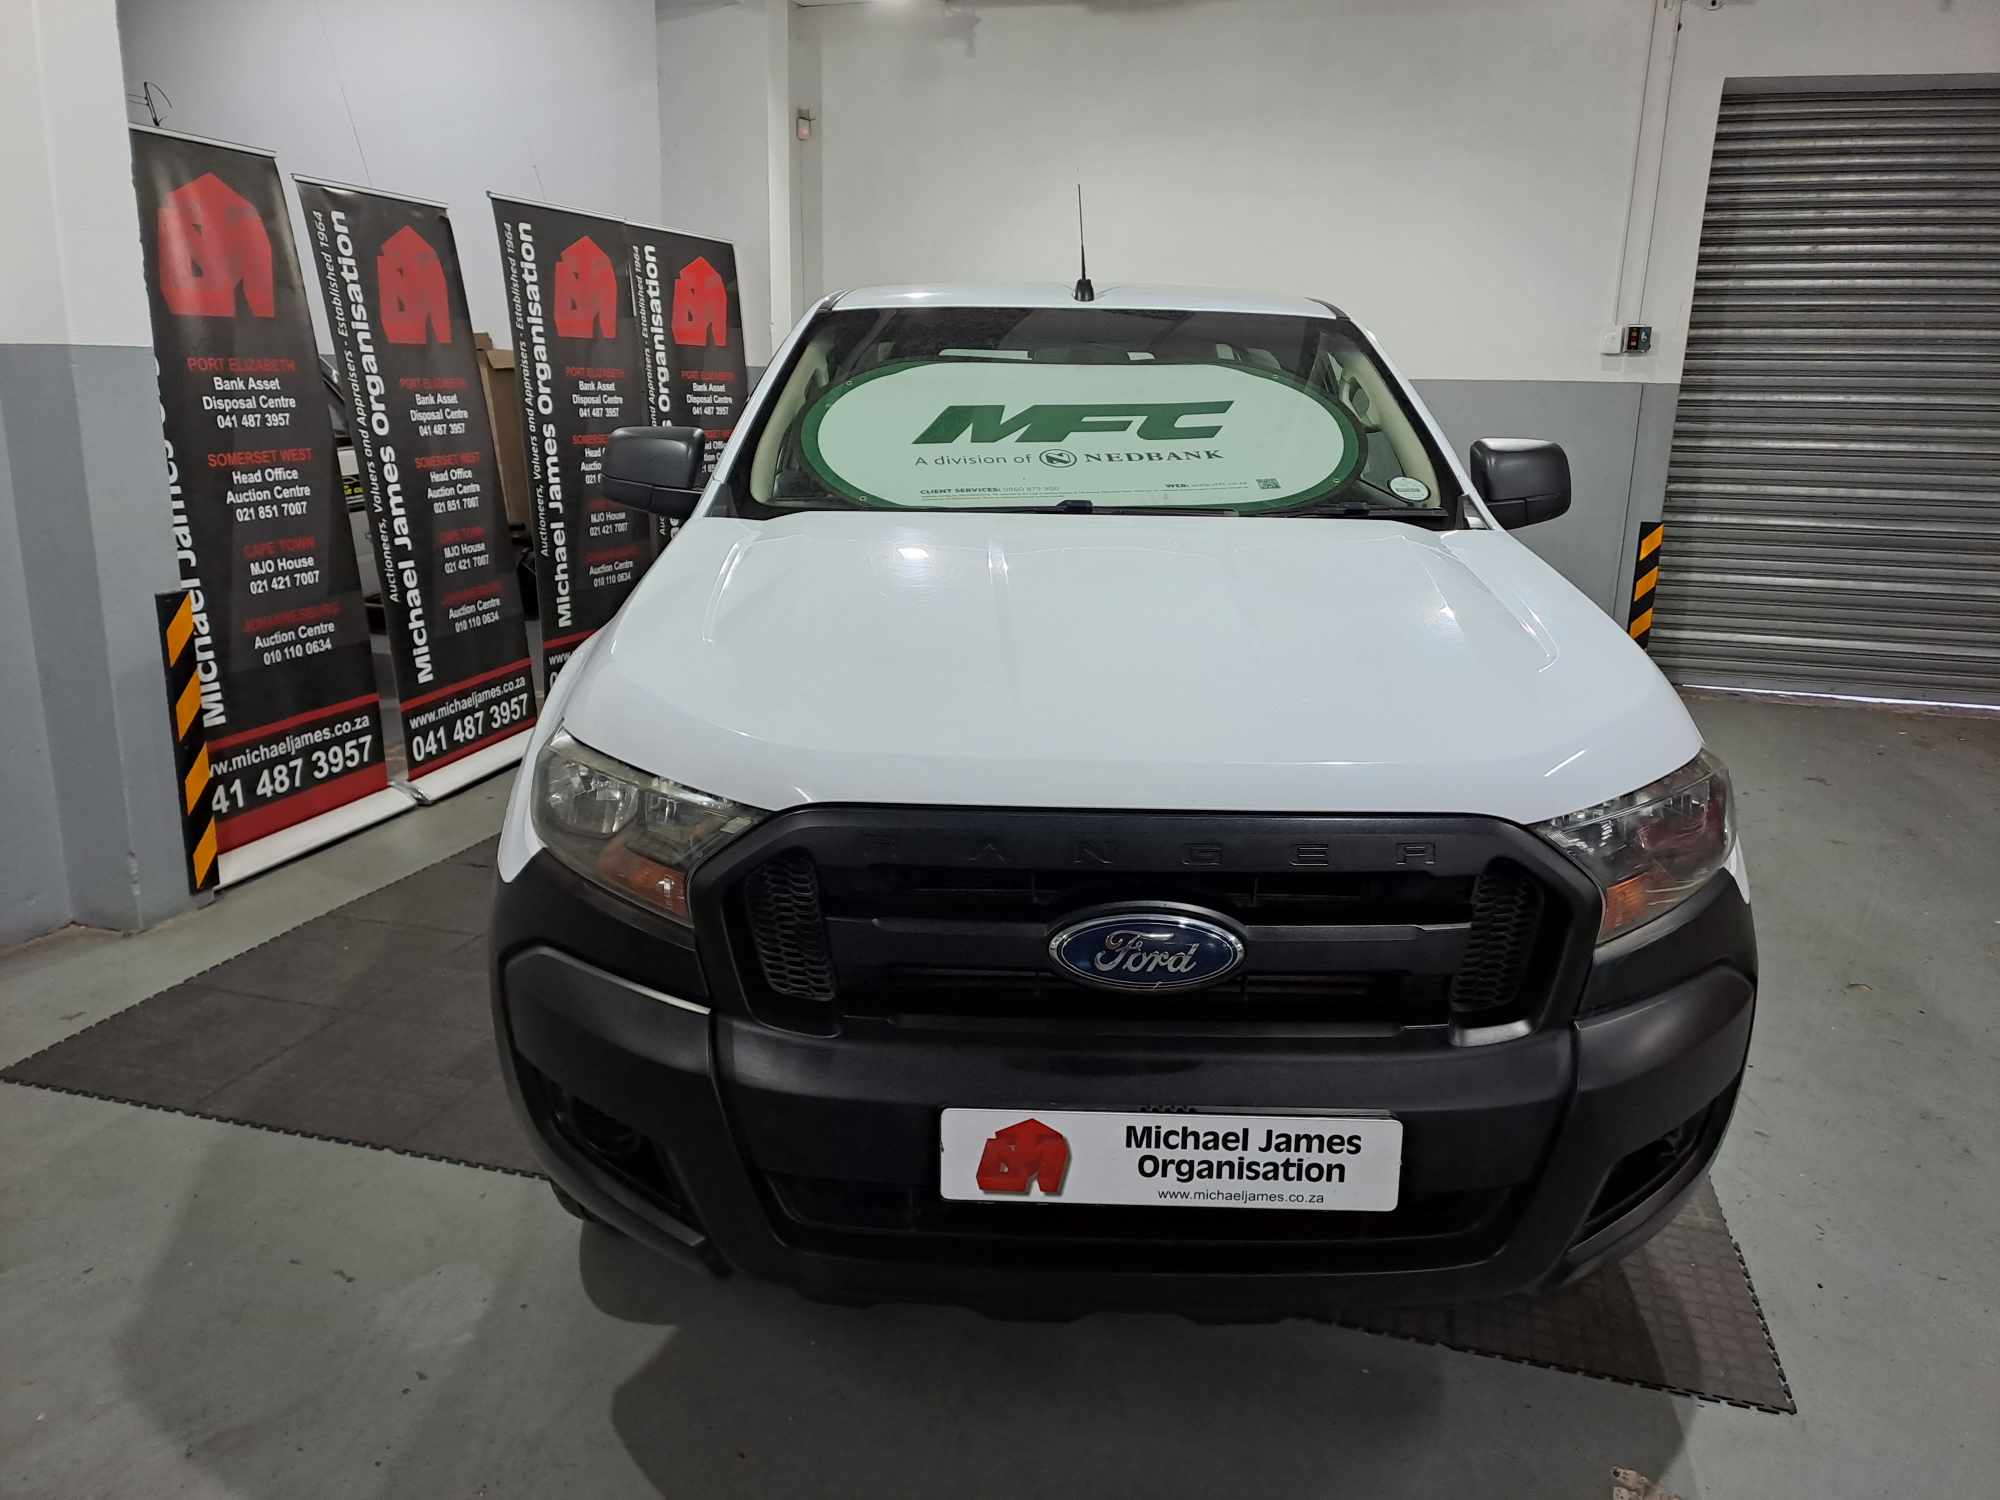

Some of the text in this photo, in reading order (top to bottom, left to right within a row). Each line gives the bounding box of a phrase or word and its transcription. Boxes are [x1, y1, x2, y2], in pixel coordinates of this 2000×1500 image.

[313, 210, 329, 249] 1964
[503, 222, 514, 253] 1964
[632, 245, 642, 273] 1964
[321, 252, 349, 337] Established
[508, 257, 524, 330] Established
[636, 275, 649, 338] Established
[518, 222, 553, 415] Organisation
[644, 244, 670, 413] Organisation
[187, 357, 225, 372] PORT
[519, 341, 533, 406] Appraisers
[213, 377, 280, 391] Bank Asset
[345, 348, 369, 428] Appraisers
[579, 381, 615, 392] Bank Asset
[693, 383, 726, 392] Bank Asset
[202, 395, 296, 412] Disposal Centre
[415, 393, 458, 405] Bank Asset
[572, 394, 623, 406] Disposal Centre
[686, 394, 712, 405] Disposal
[217, 412, 290, 428] 041 487 3957
[410, 408, 468, 422] Disposal Centre
[525, 407, 537, 432] and
[579, 408, 590, 418] 041
[592, 407, 603, 417] 487
[912, 400, 1234, 445] MFC
[419, 423, 465, 436] 041 487 3957
[331, 209, 434, 685] Michael James Organisation
[358, 429, 373, 458] and
[208, 448, 312, 467] SOMERSET WEST
[530, 434, 542, 480] Valuers
[581, 461, 602, 472] Auctio
[915, 456, 928, 466] A
[934, 454, 1008, 466] division
[1013, 453, 1034, 464] of
[1084, 449, 1225, 465] NEDBANK
[232, 467, 298, 485] Head Office
[430, 468, 473, 482] Head Office
[543, 423, 563, 514] James
[226, 485, 311, 504] Auction Centre
[367, 460, 384, 513] Valuers
[427, 483, 480, 499] Auction Centre
[236, 501, 308, 522] 021 851 7007
[433, 502, 446, 514] 021
[447, 499, 460, 511] 851
[606, 512, 626, 521] House
[461, 542, 486, 554] House
[250, 555, 315, 576] MJO House
[444, 562, 457, 574] 021
[458, 558, 471, 571] 421
[550, 521, 572, 628] Michael
[590, 563, 613, 575] Auction
[250, 570, 320, 595] 021 421 7007
[449, 598, 500, 620] Auction Centre
[254, 621, 335, 649] Auction Centre
[455, 620, 468, 633] 010
[468, 616, 481, 630] 110
[264, 638, 332, 665] 010 110 0634
[409, 675, 526, 729] www.michaeljames.co.za
[412, 693, 528, 762] 041 487 3957
[210, 715, 370, 778] w.michaeljames.co.za
[211, 734, 373, 814] 41 487 3957
[1094, 929, 1200, 975] Ford
[1125, 1125, 1363, 1155] Michael James
[1137, 1154, 1346, 1186] Organisation
[1158, 1188, 1325, 1205] www.michaeljames.co.za
